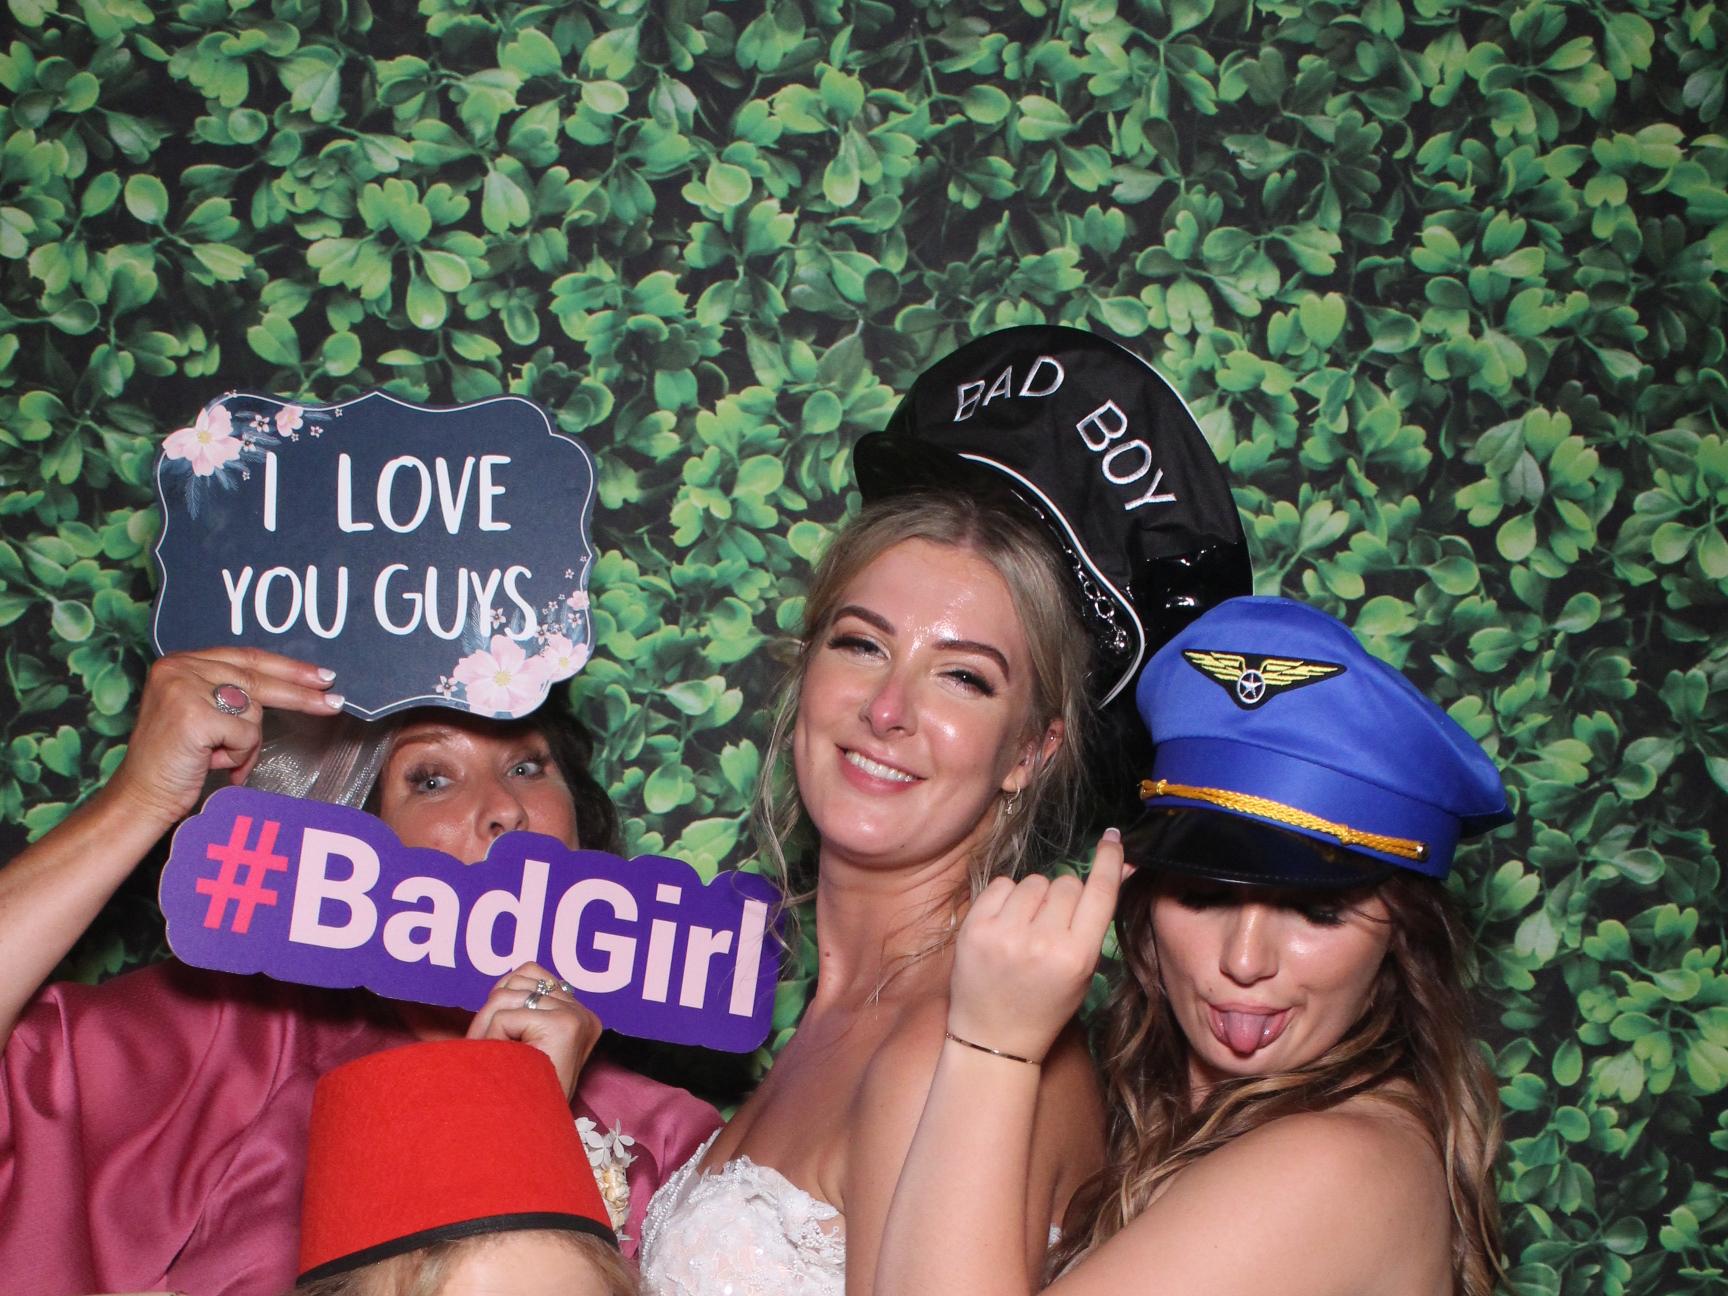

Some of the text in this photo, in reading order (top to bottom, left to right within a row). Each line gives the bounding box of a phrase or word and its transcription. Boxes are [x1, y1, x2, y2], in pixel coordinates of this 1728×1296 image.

[263, 451, 511, 534] I LOVE
[953, 355, 1178, 511] BAD BOY
[222, 564, 538, 641] YOU GUYS
[195, 815, 769, 1018] #BadGirl
